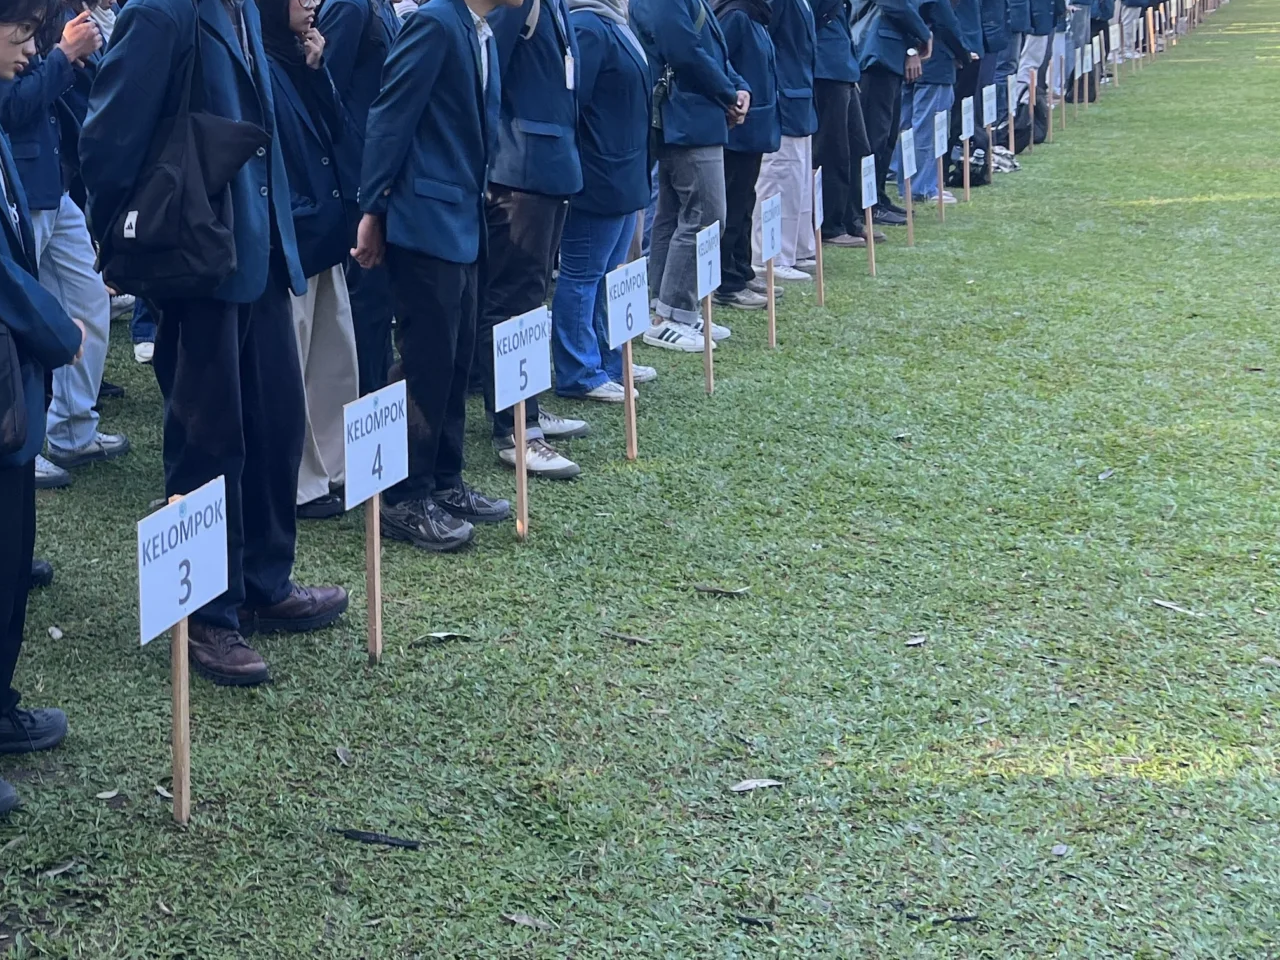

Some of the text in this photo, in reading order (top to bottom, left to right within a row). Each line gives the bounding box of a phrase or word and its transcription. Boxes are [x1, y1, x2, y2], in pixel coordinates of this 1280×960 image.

[608, 271, 647, 301] KELOMPOK
[707, 259, 713, 287] 7
[625, 302, 634, 332] 6
[496, 320, 549, 359] KELOMPOK
[518, 357, 529, 392] 5
[346, 398, 406, 445] KELOMPOK
[371, 443, 384, 481] 4
[142, 496, 225, 567] KELOMPOK
[178, 558, 193, 607] 3
